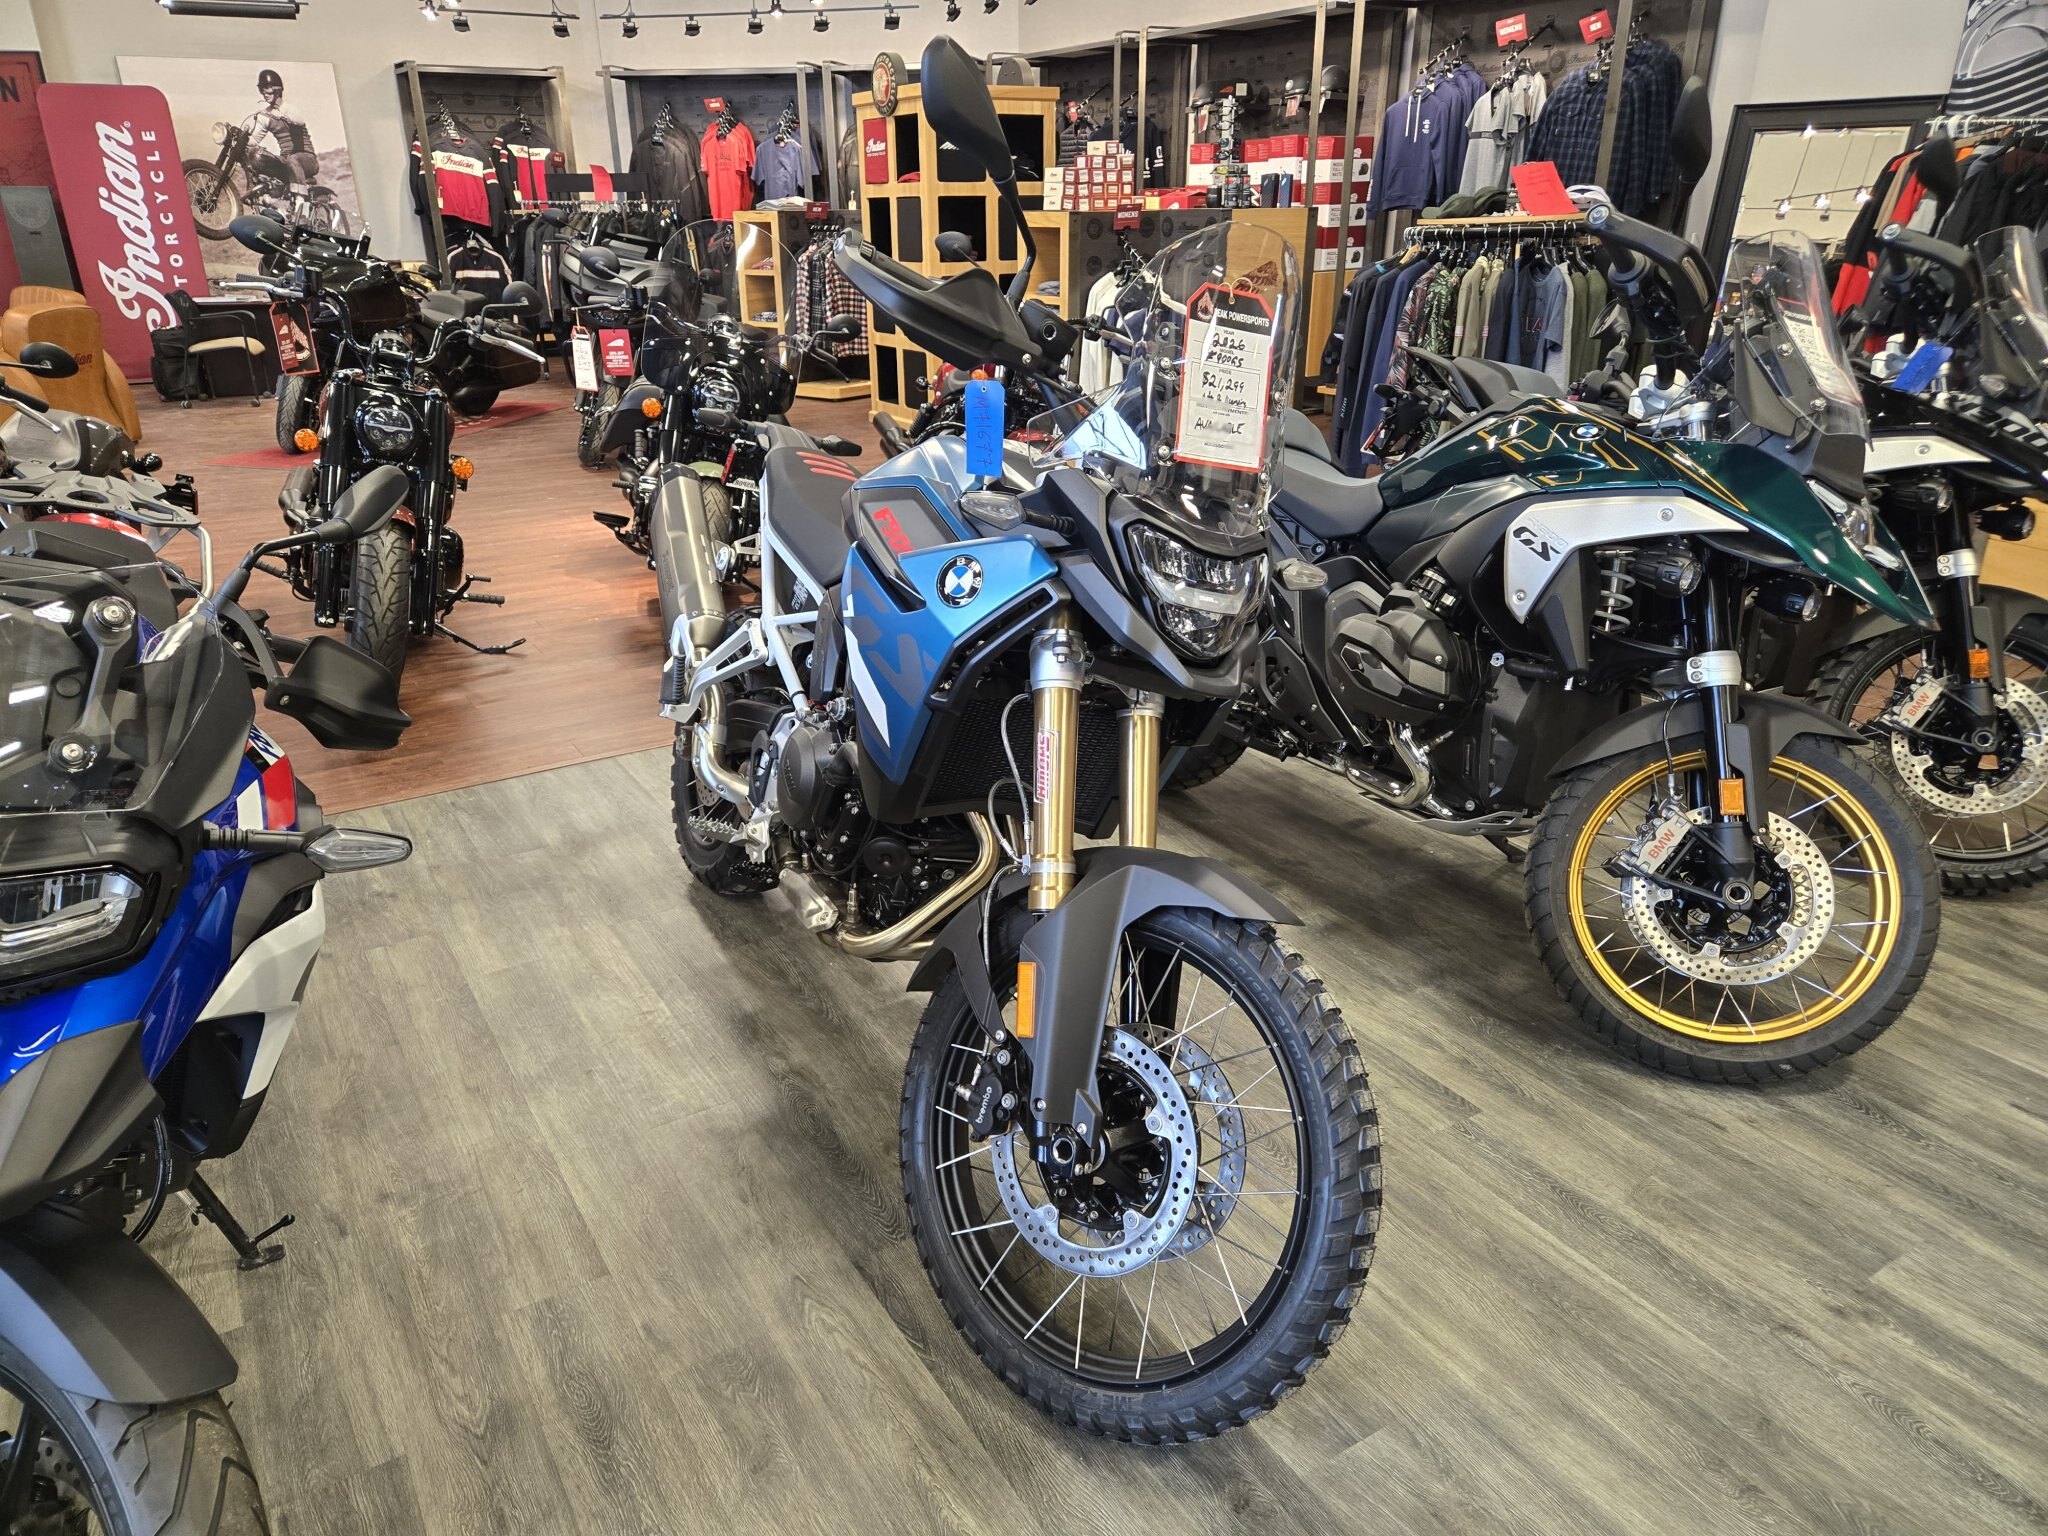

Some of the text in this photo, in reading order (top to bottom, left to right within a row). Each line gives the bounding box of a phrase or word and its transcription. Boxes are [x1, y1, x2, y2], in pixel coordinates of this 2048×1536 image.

[865, 137, 887, 154] Indian
[440, 153, 475, 170] Indian
[141, 129, 189, 288] TORCYCLE
[1117, 211, 1139, 219] WOMENS
[95, 121, 178, 333] Indian
[1228, 312, 1270, 328] POWERSPORTS
[1202, 371, 1245, 393] $21,299
[872, 504, 918, 554] F90
[1512, 526, 1563, 562] GS
[1907, 692, 1930, 717] BMW
[1648, 828, 1675, 859] BMW
[975, 1086, 993, 1124] brembo
